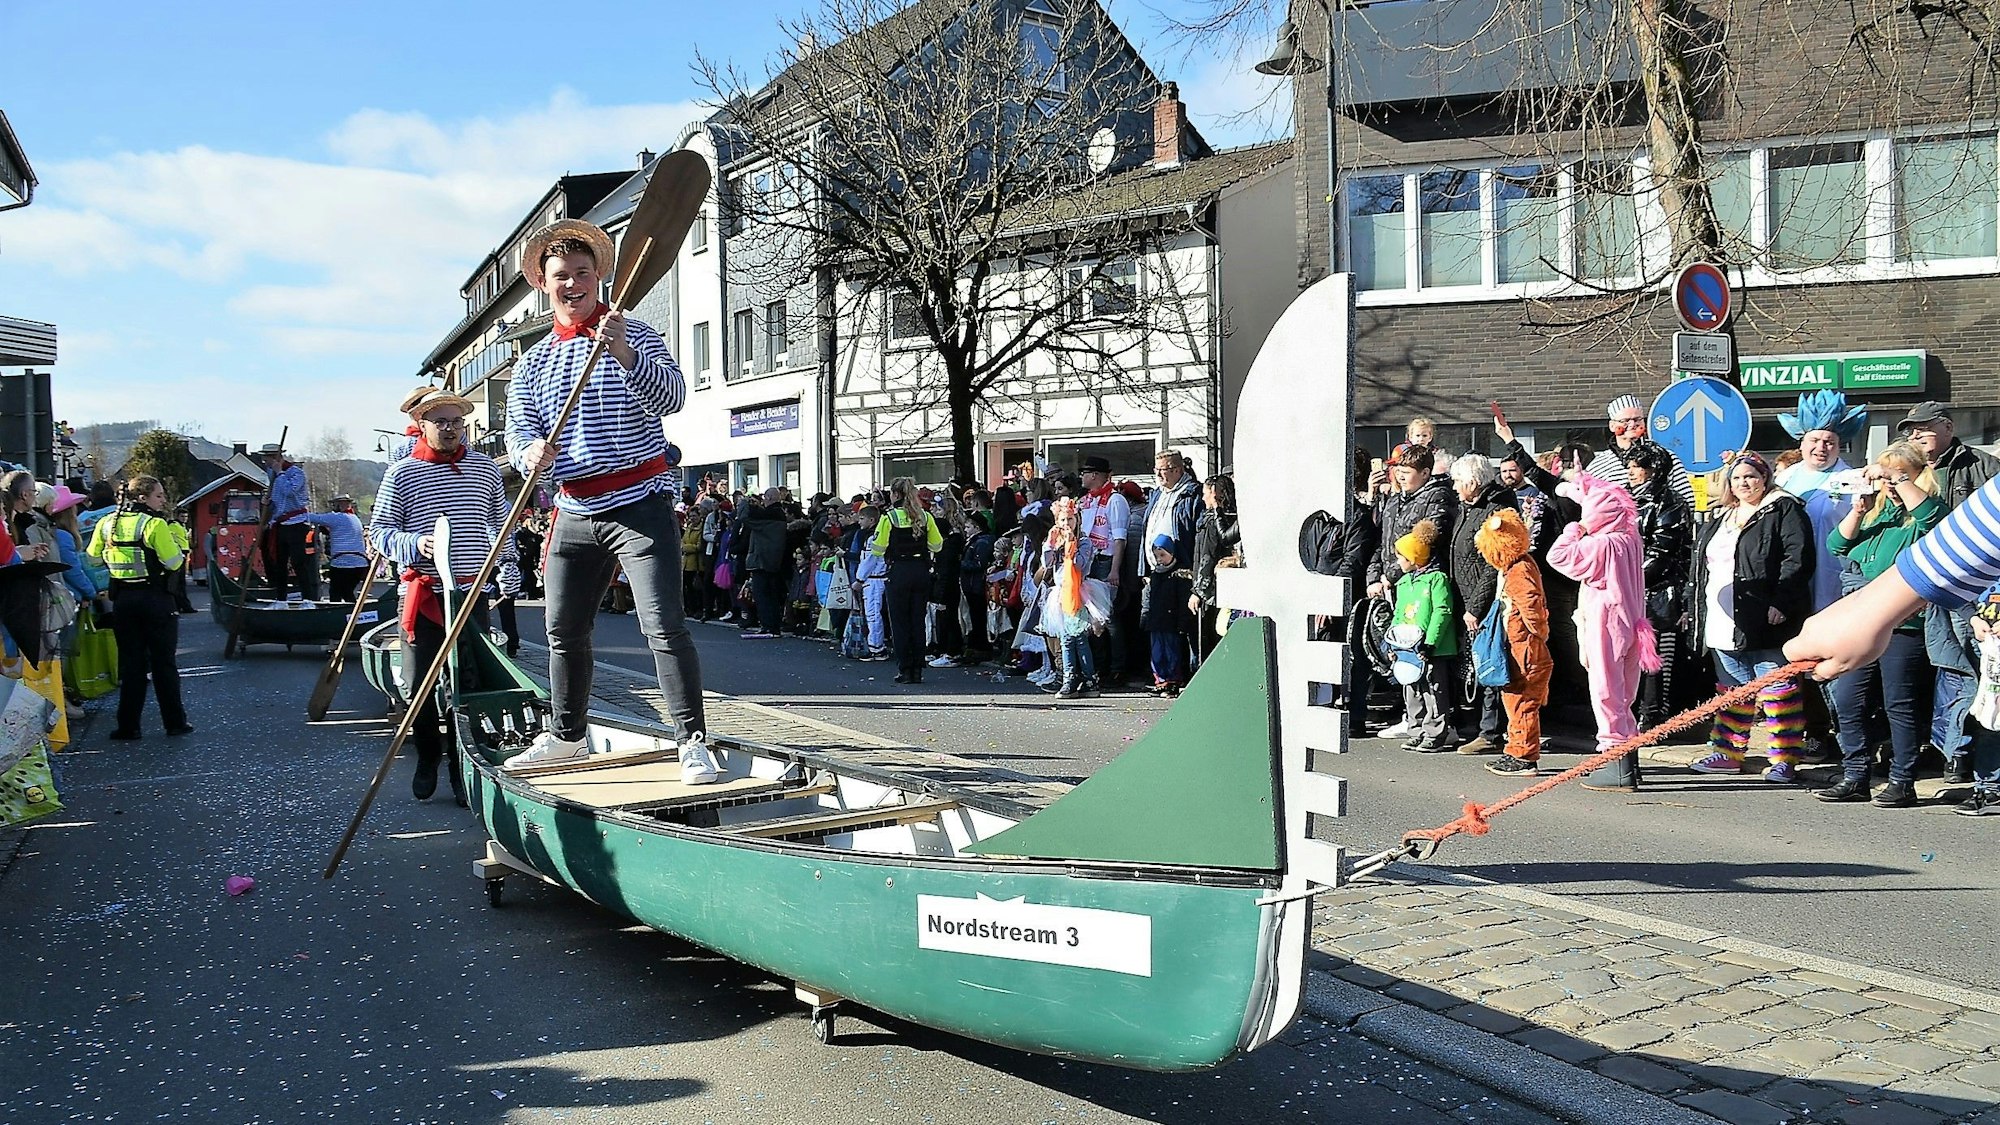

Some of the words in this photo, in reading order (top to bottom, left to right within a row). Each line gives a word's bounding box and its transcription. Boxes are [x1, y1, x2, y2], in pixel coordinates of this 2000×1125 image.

[1689, 341, 1700, 351] auf
[1703, 341, 1718, 352] dem
[1681, 352, 1727, 365] Seitenstreifen
[1852, 362, 1911, 372] Geschäftsstelle
[1741, 364, 1832, 387] VINZIAL
[1854, 374, 1870, 382] Ralf
[1871, 373, 1909, 381] Eiteneuer
[740, 410, 760, 423] Bender
[766, 405, 787, 418] Bender
[927, 914, 1058, 945] Nordstream
[1066, 926, 1080, 947] 3
